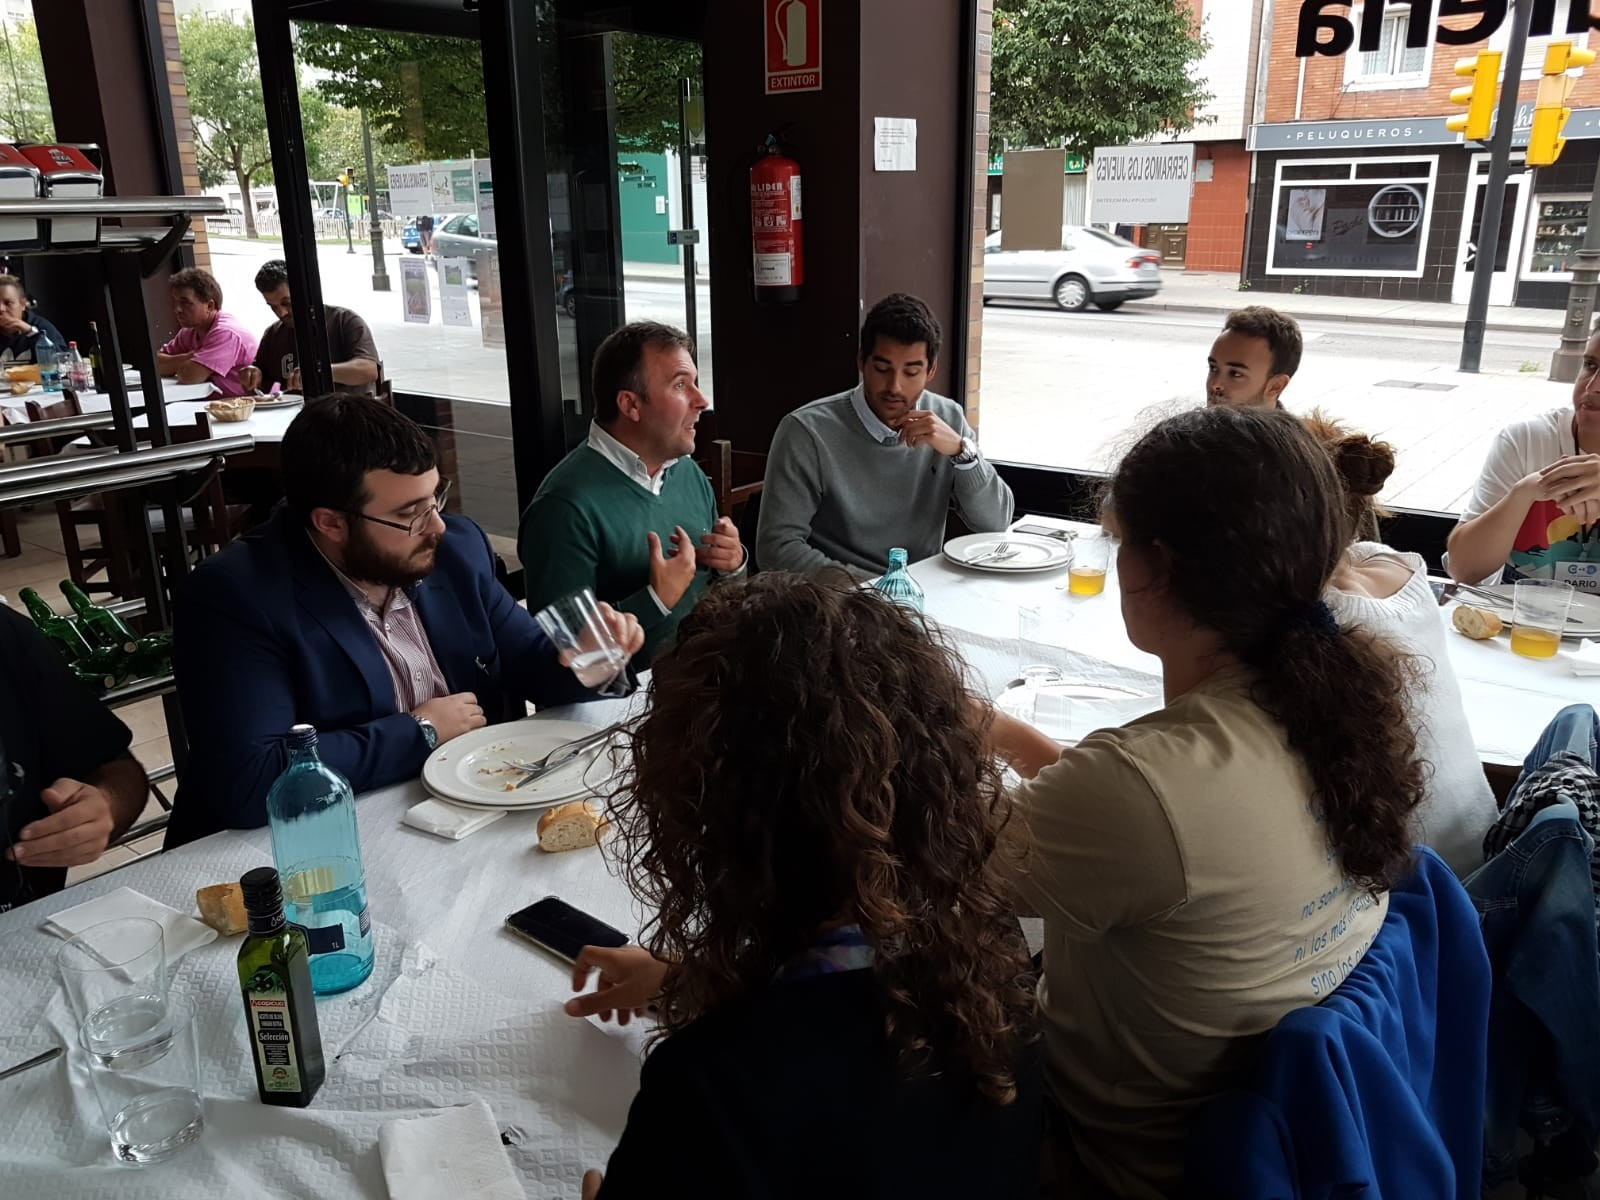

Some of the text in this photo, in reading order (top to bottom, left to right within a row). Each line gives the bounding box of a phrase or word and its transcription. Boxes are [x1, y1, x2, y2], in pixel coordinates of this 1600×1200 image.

[771, 74, 815, 88] EXTINTOR
[1296, 126, 1413, 141] PELUQUEROS
[1564, 579, 1598, 589] DARIO
[1311, 933, 1327, 955] los
[1311, 968, 1338, 996] sino
